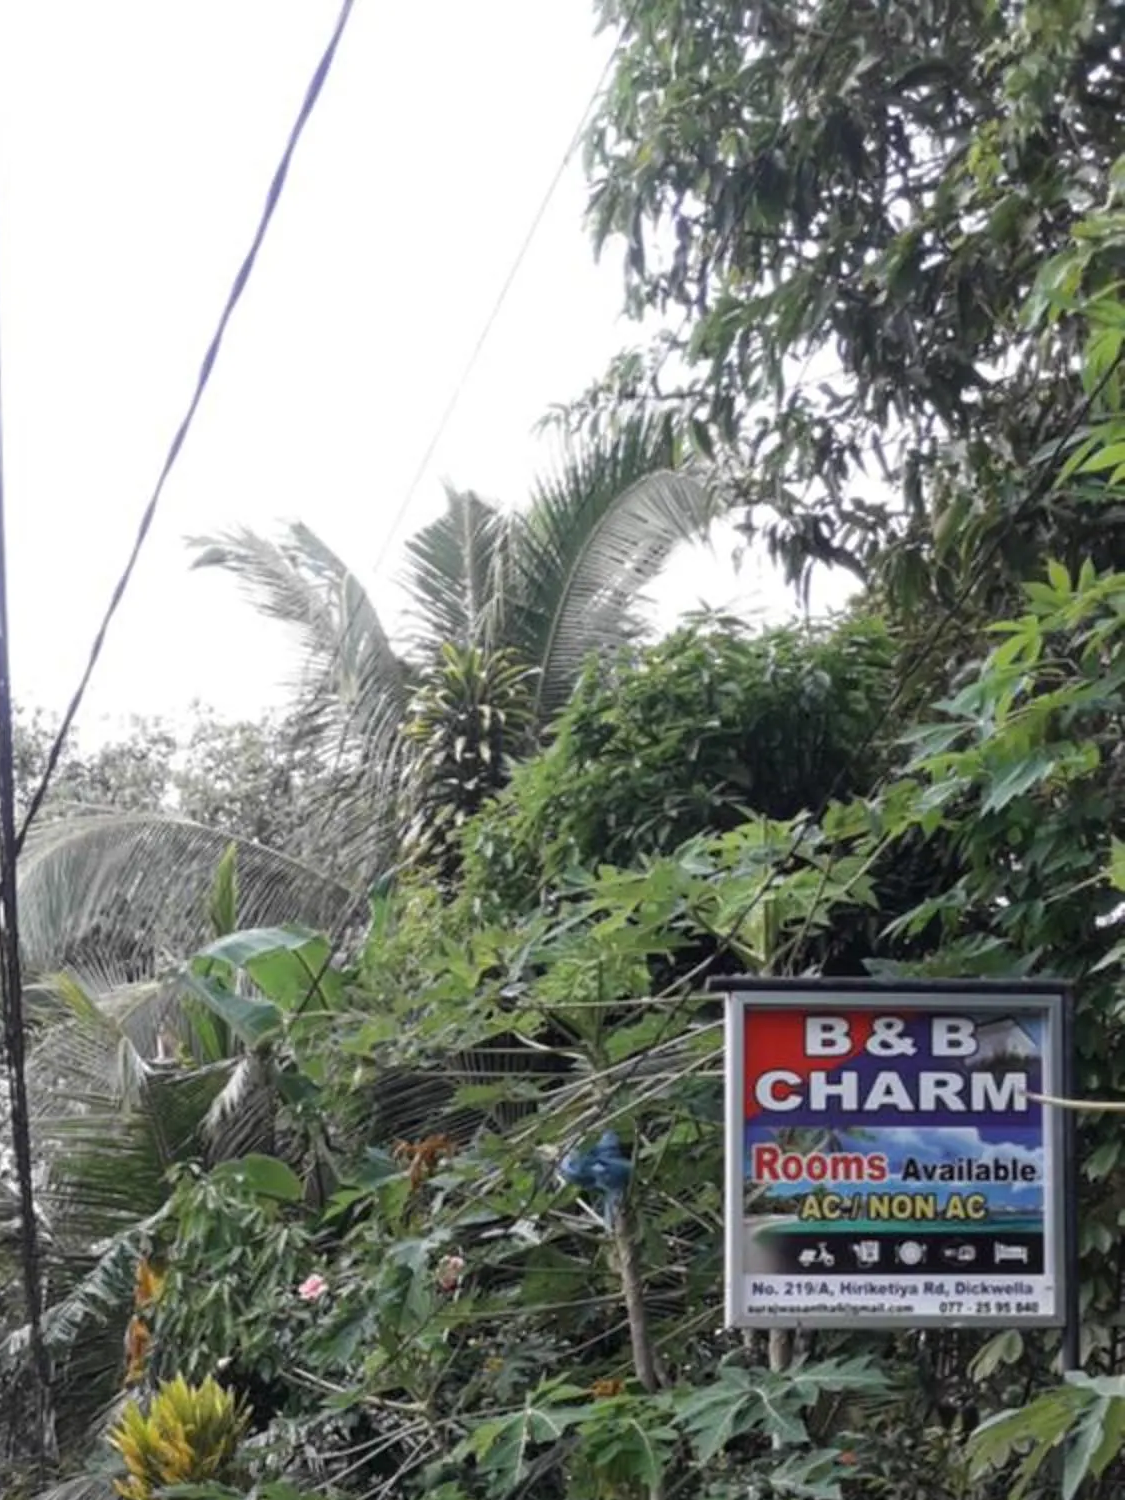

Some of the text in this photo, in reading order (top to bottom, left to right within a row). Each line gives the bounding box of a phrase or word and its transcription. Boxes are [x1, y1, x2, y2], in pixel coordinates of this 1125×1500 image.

[754, 1069, 1028, 1112] CHARM
[752, 1145, 1036, 1183] Rooms Available
[868, 1194, 937, 1220] NON
[946, 1194, 987, 1220] AC
[751, 1281, 779, 1296] No.
[839, 1280, 918, 1298] Hiriketiya
[923, 1281, 950, 1298] Rd,
[954, 1279, 1033, 1297] Dickwella
